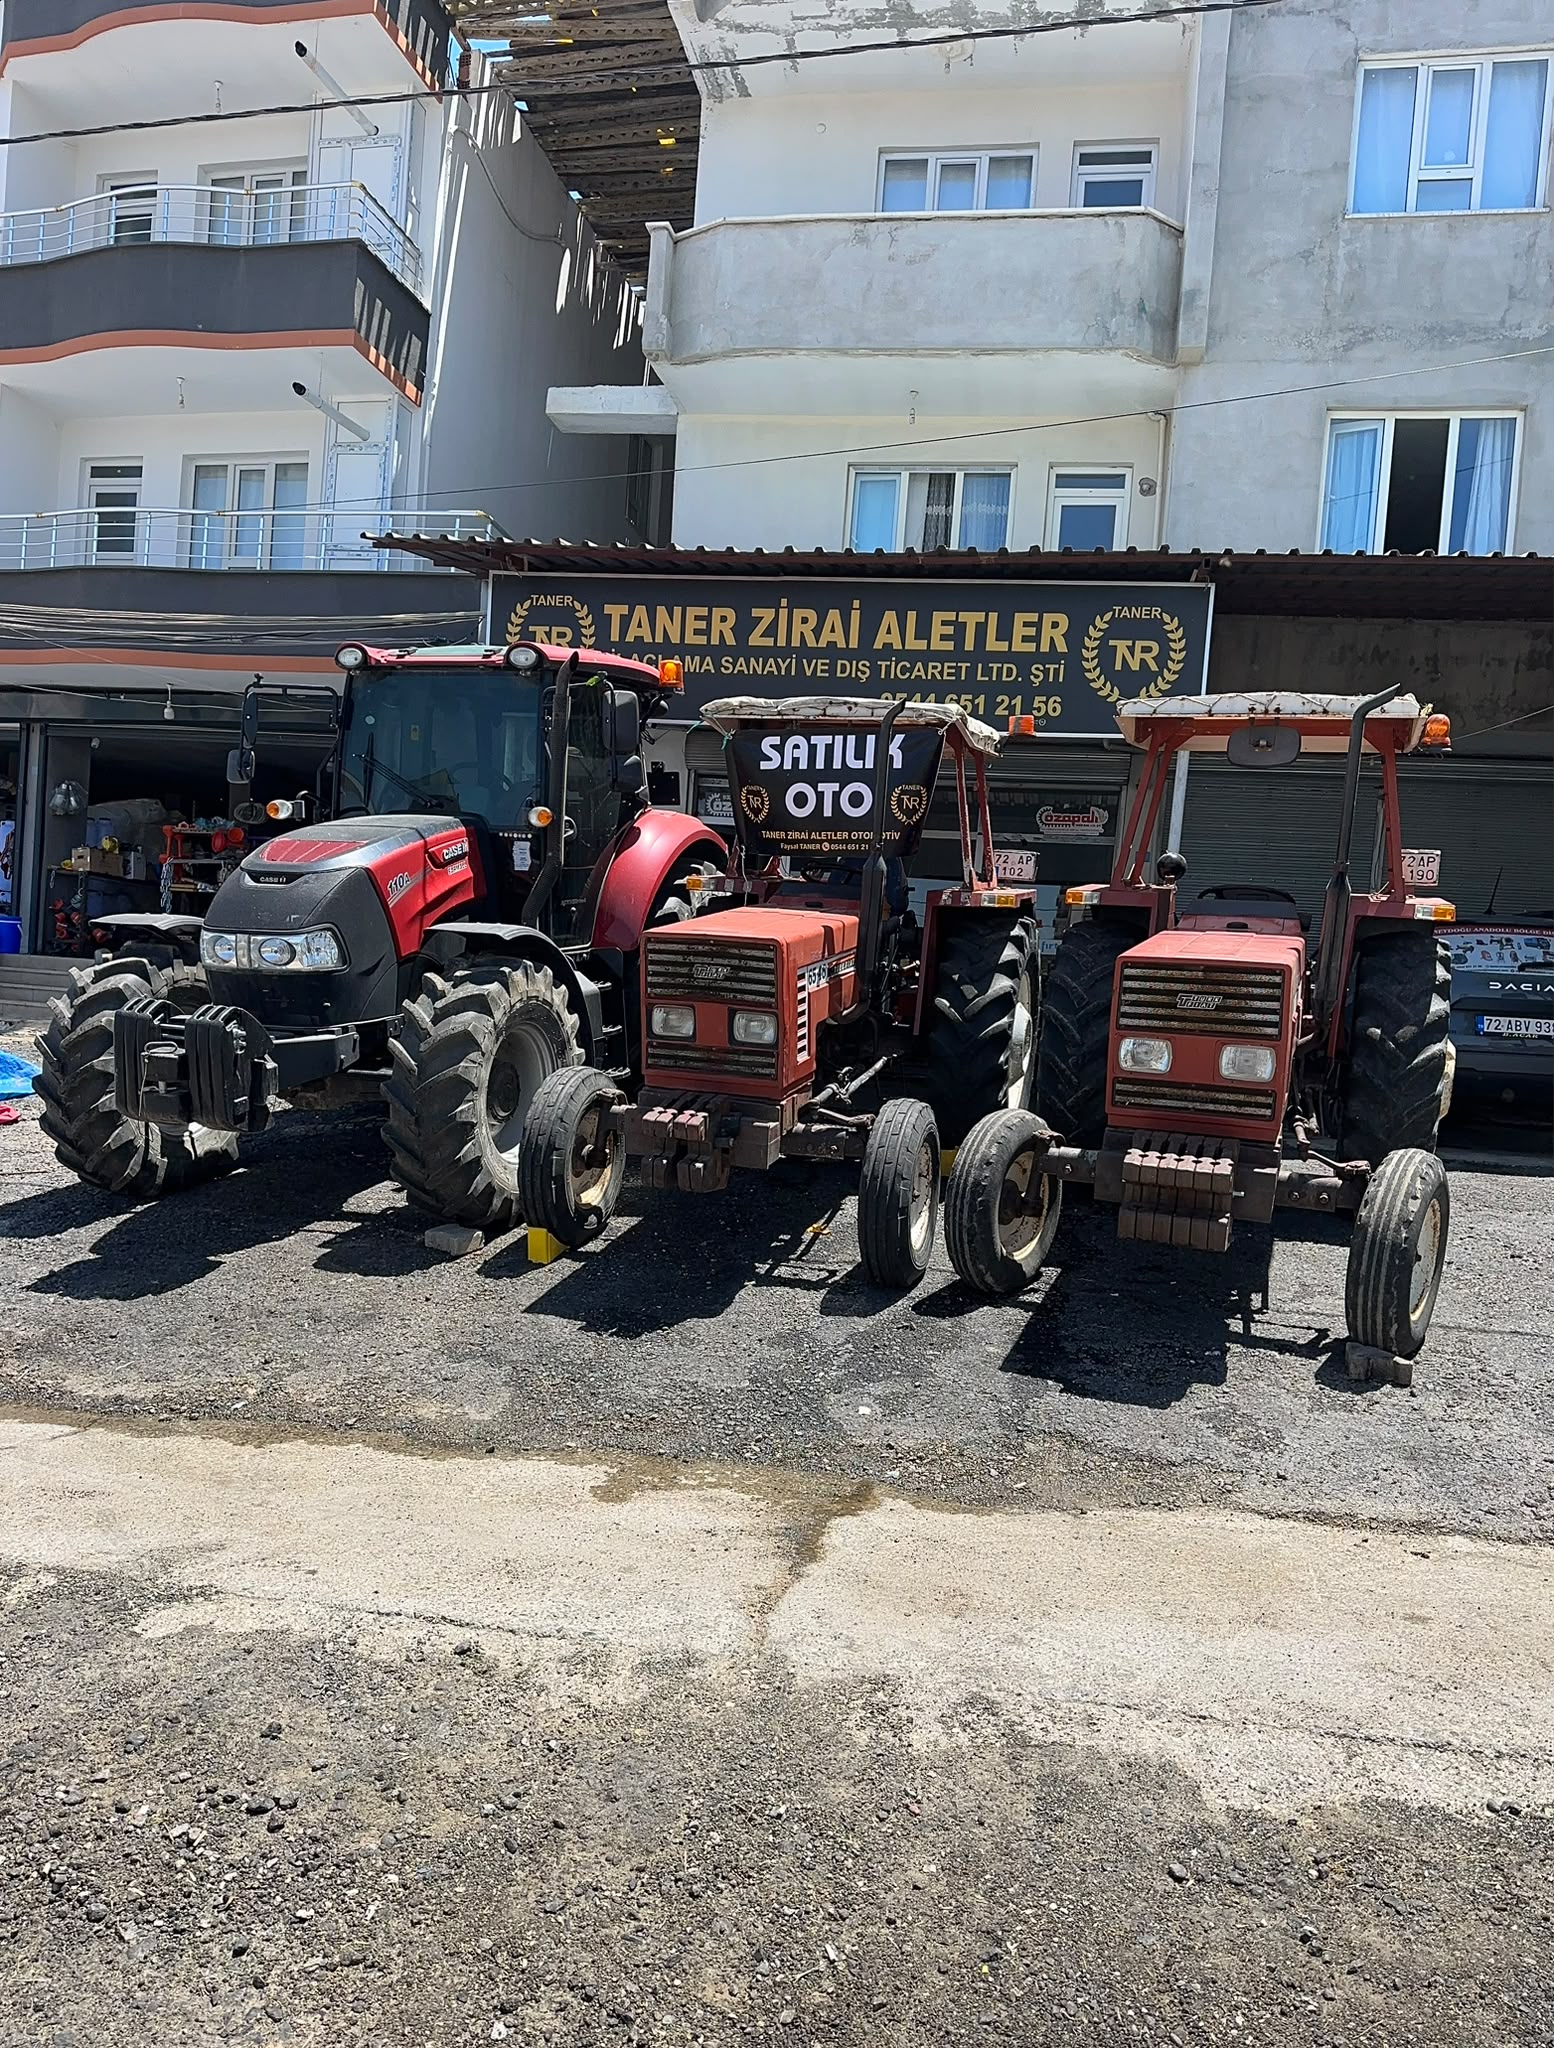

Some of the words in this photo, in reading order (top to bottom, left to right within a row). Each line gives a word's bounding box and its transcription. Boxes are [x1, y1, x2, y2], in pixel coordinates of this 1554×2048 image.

[530, 595, 573, 606] TANER
[1113, 606, 1161, 619] TANER
[604, 604, 736, 646] TANER
[748, 598, 861, 649] ZİRAİ
[873, 610, 1070, 653] ALETLER
[720, 654, 797, 677] SANAYİ
[802, 658, 830, 677] VE
[836, 659, 871, 682] DIŞ
[877, 657, 970, 681] TİCARET
[976, 662, 1023, 682] LTD.
[1029, 660, 1065, 686] ŞTİ
[994, 695, 1022, 716] 21
[1032, 696, 1062, 717] 56
[760, 734, 906, 770] SATILIK
[785, 782, 873, 818] OTO
[761, 831, 786, 839] TANER
[787, 830, 809, 839] ZİRAİ
[810, 831, 849, 840] ALETLER
[851, 830, 901, 840] OTOTİV
[443, 842, 462, 860] CASE
[780, 843, 799, 851] Faysal
[995, 854, 1010, 864] 72
[1017, 855, 1033, 865] AP
[1002, 866, 1024, 877] 102
[1409, 869, 1434, 880] 190
[387, 871, 411, 896] 110A
[1489, 982, 1554, 992] DACIA
[1485, 1018, 1502, 1031] 72
[1506, 1020, 1531, 1032] ABV
[1535, 1021, 1554, 1034] 93
